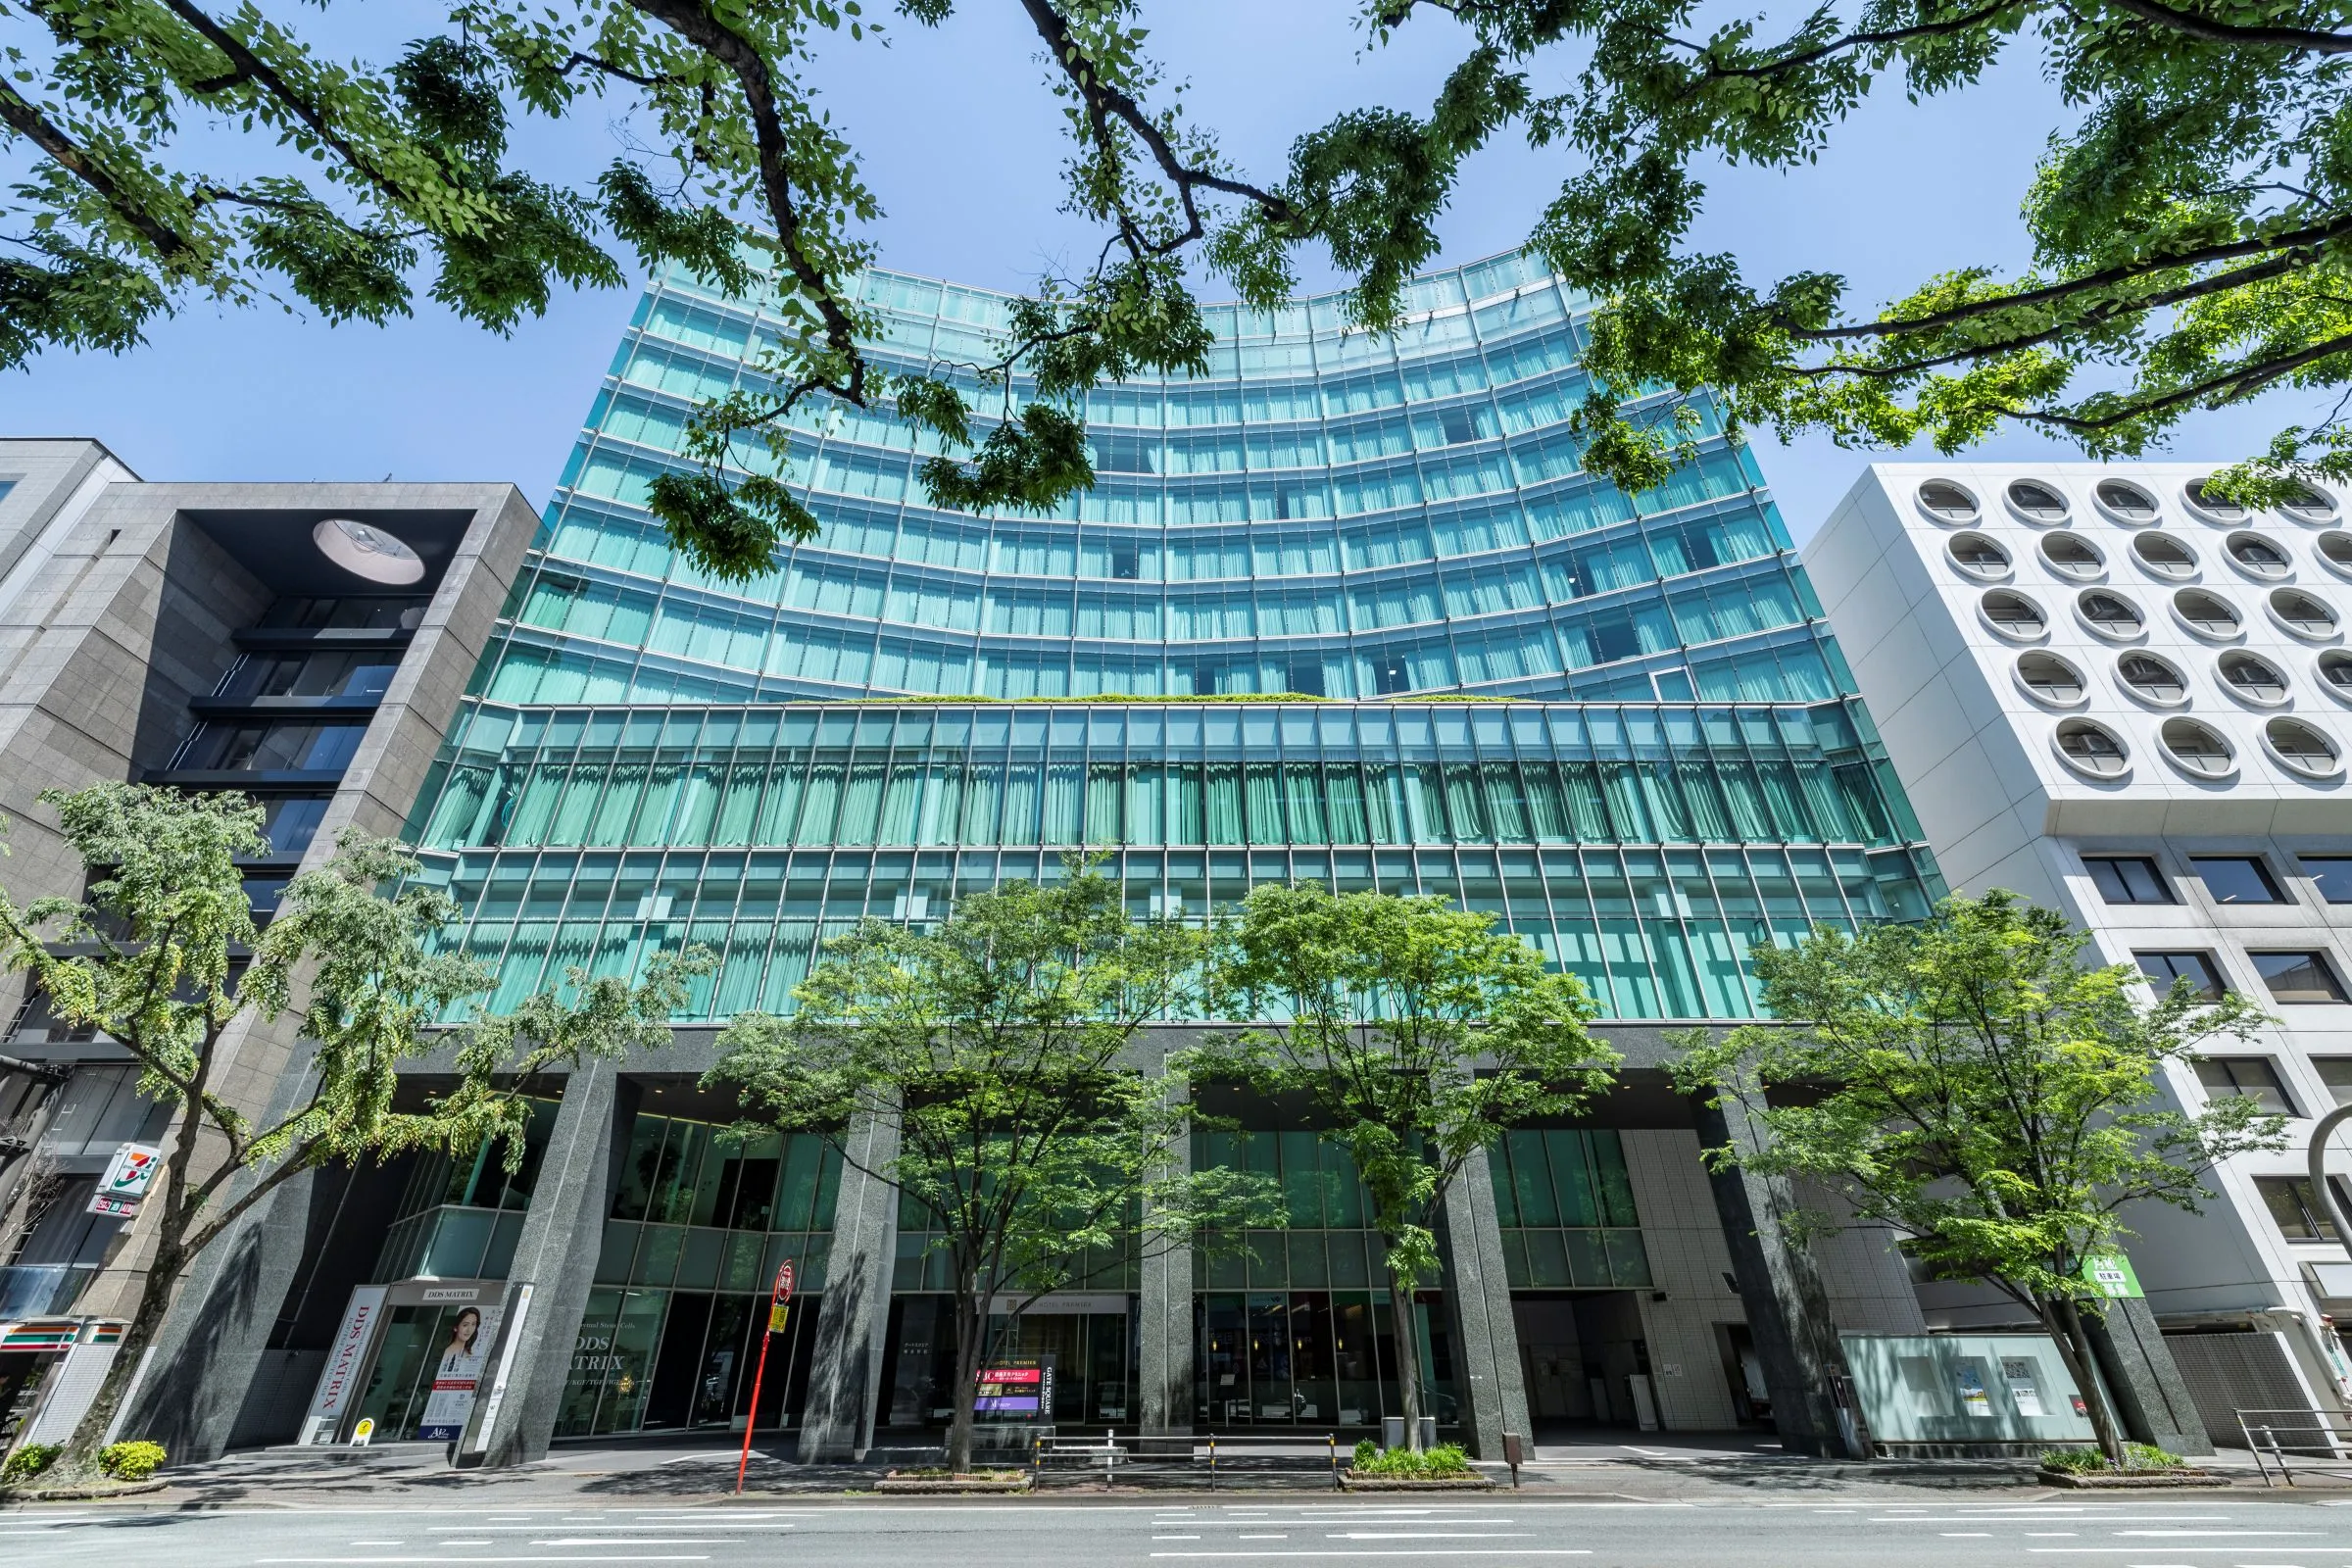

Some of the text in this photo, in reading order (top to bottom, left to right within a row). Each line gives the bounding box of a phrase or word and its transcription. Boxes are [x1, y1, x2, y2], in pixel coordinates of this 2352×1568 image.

[322, 1305, 369, 1409] DDS MATRIX
[568, 1355, 625, 1370] TRIX
